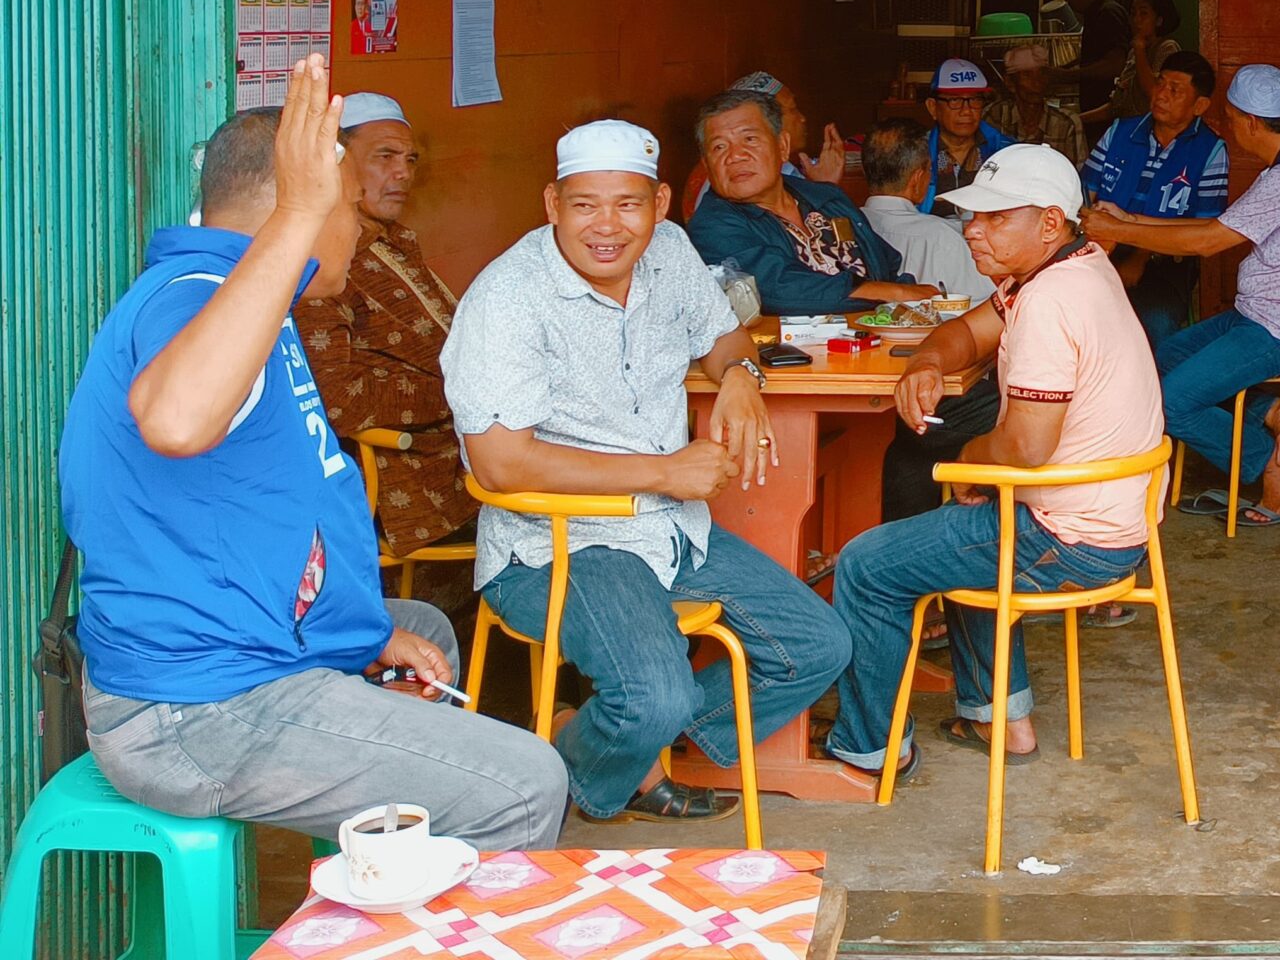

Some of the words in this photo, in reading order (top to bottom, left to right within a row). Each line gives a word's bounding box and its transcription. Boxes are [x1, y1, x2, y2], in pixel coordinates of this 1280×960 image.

[950, 71, 977, 82] S14P
[1159, 183, 1192, 216] 14
[1010, 388, 1064, 400] SELECTION
